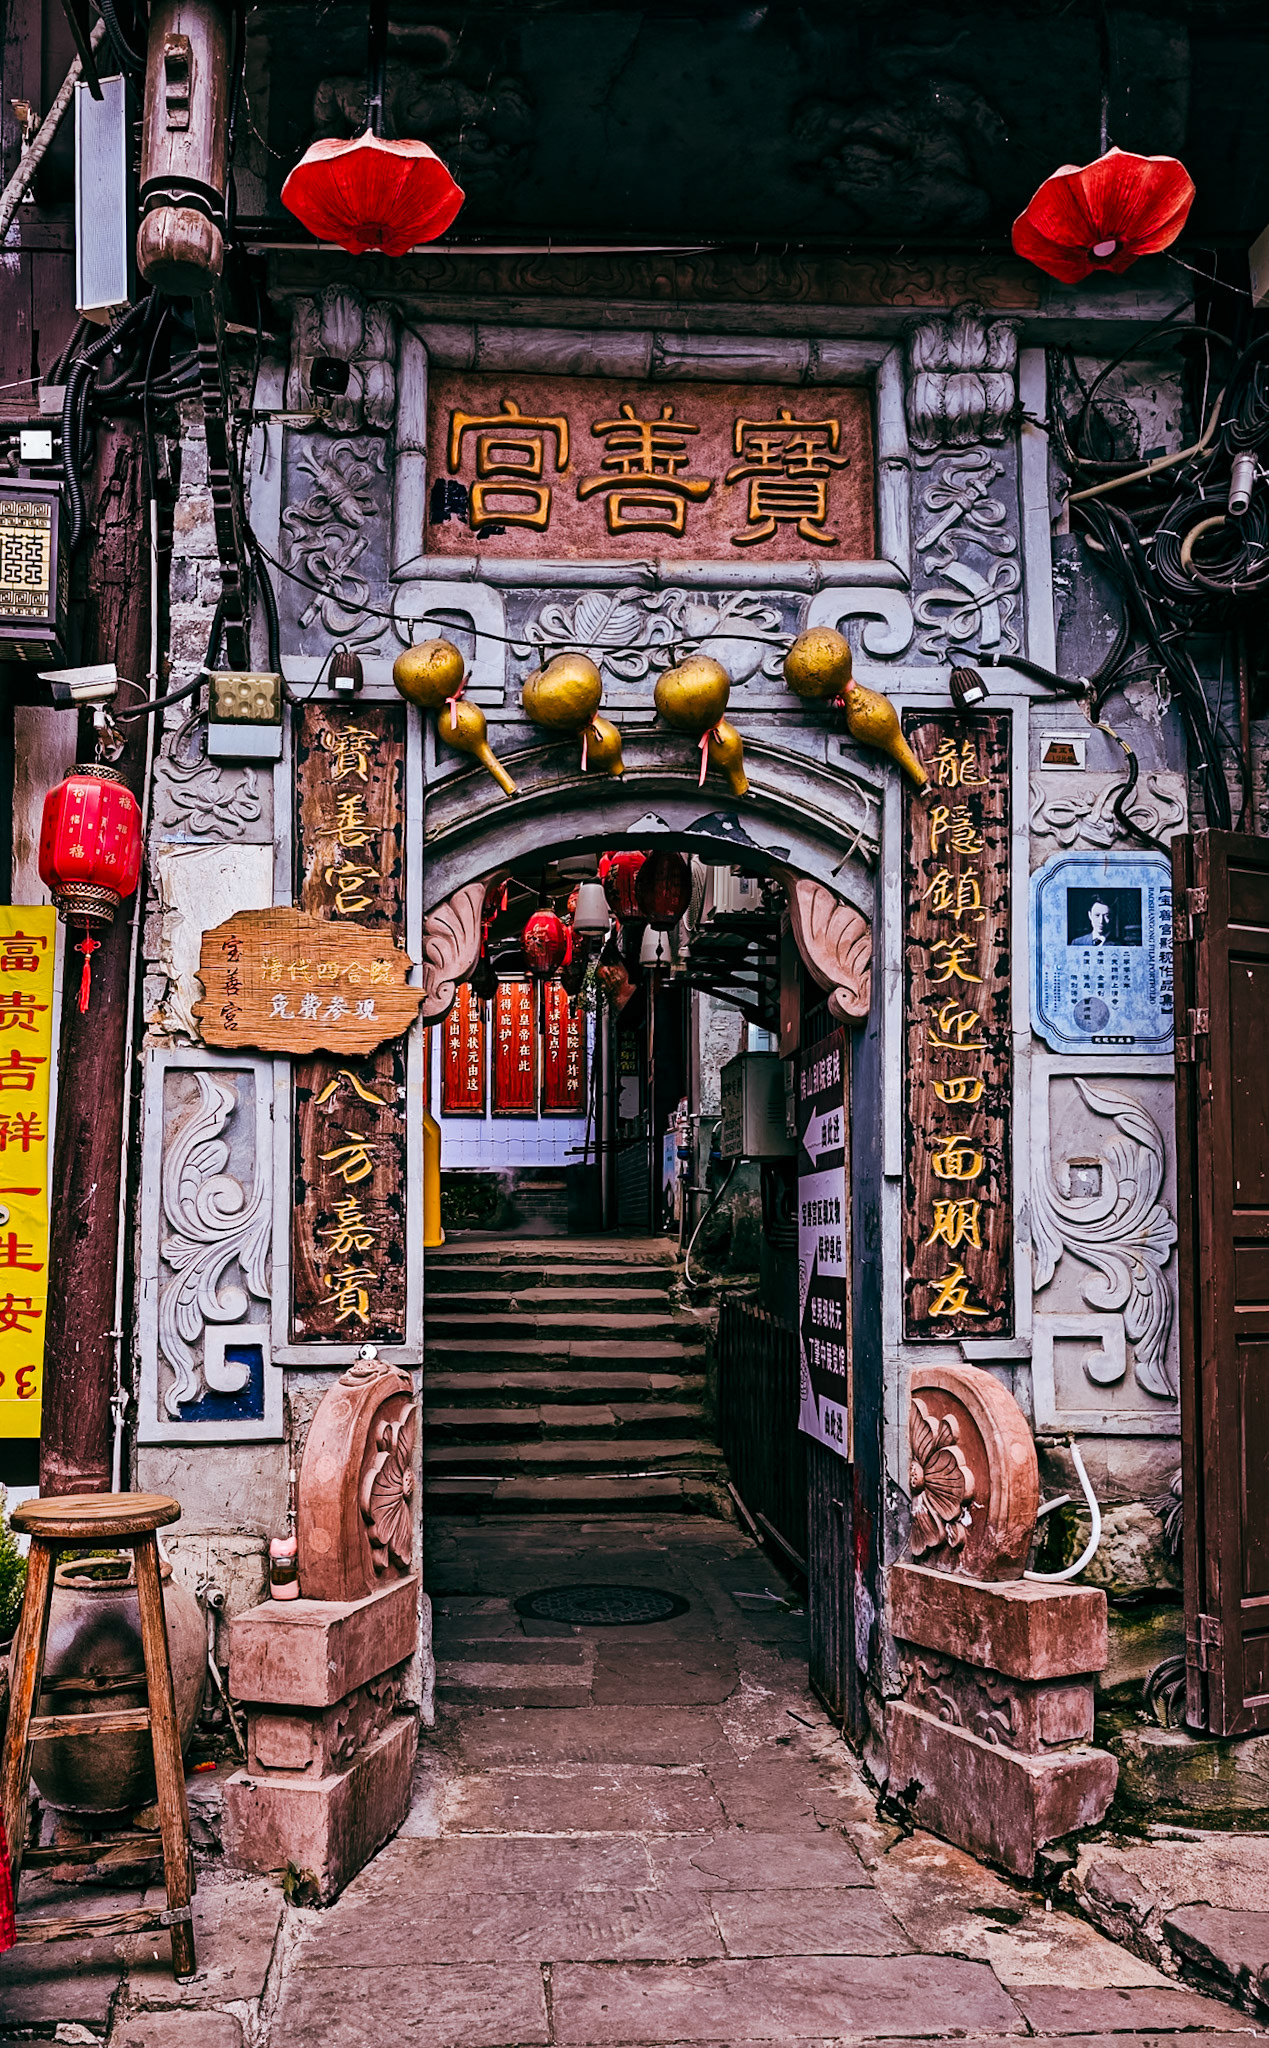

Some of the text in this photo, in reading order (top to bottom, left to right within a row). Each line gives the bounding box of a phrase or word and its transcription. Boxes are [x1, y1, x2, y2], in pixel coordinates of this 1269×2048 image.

[220, 935, 244, 1031] 宝善宫
[261, 955, 396, 985] 清代四合院
[269, 992, 379, 1022] 免费参观
[499, 983, 512, 1056] 获得庇护？
[518, 984, 531, 1072] 哪位皇帝在此
[922, 738, 991, 1317] 龍隱鎮笑迎四面朋友
